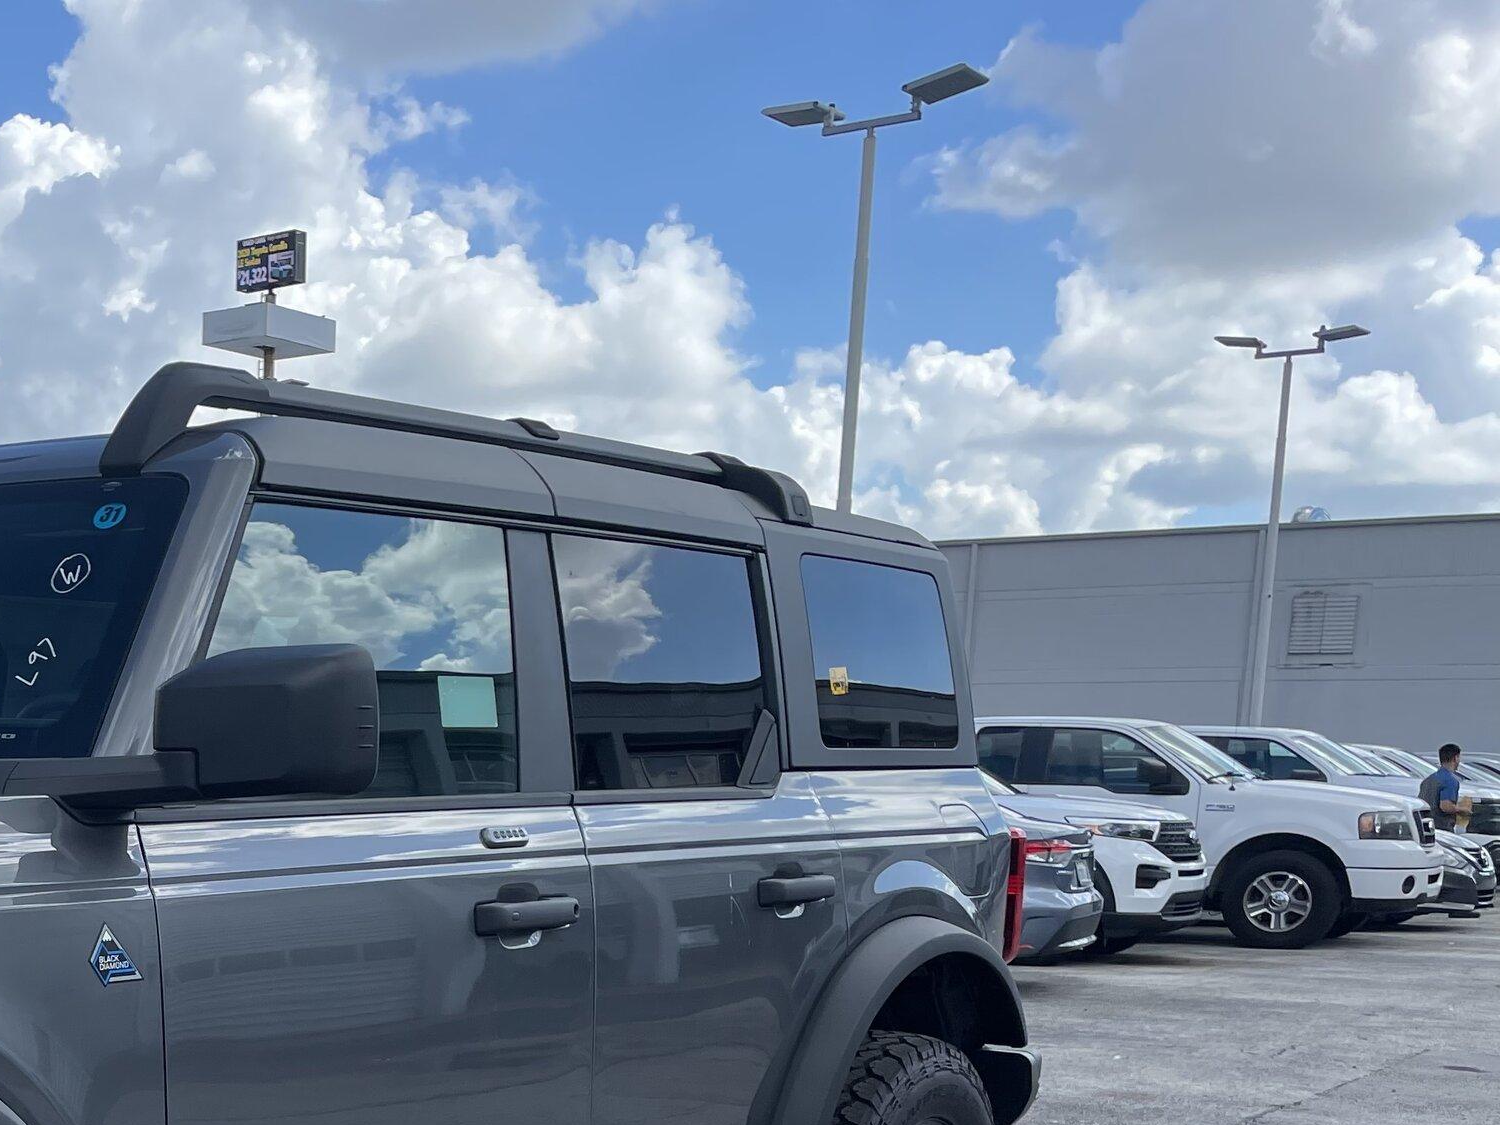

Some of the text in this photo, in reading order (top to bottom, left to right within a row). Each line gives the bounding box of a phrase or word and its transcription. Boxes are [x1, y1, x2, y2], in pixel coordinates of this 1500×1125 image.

[99, 506, 123, 523] 31
[59, 564, 81, 585] W
[99, 954, 120, 964] BLACK
[100, 961, 129, 971] DIAMOND
